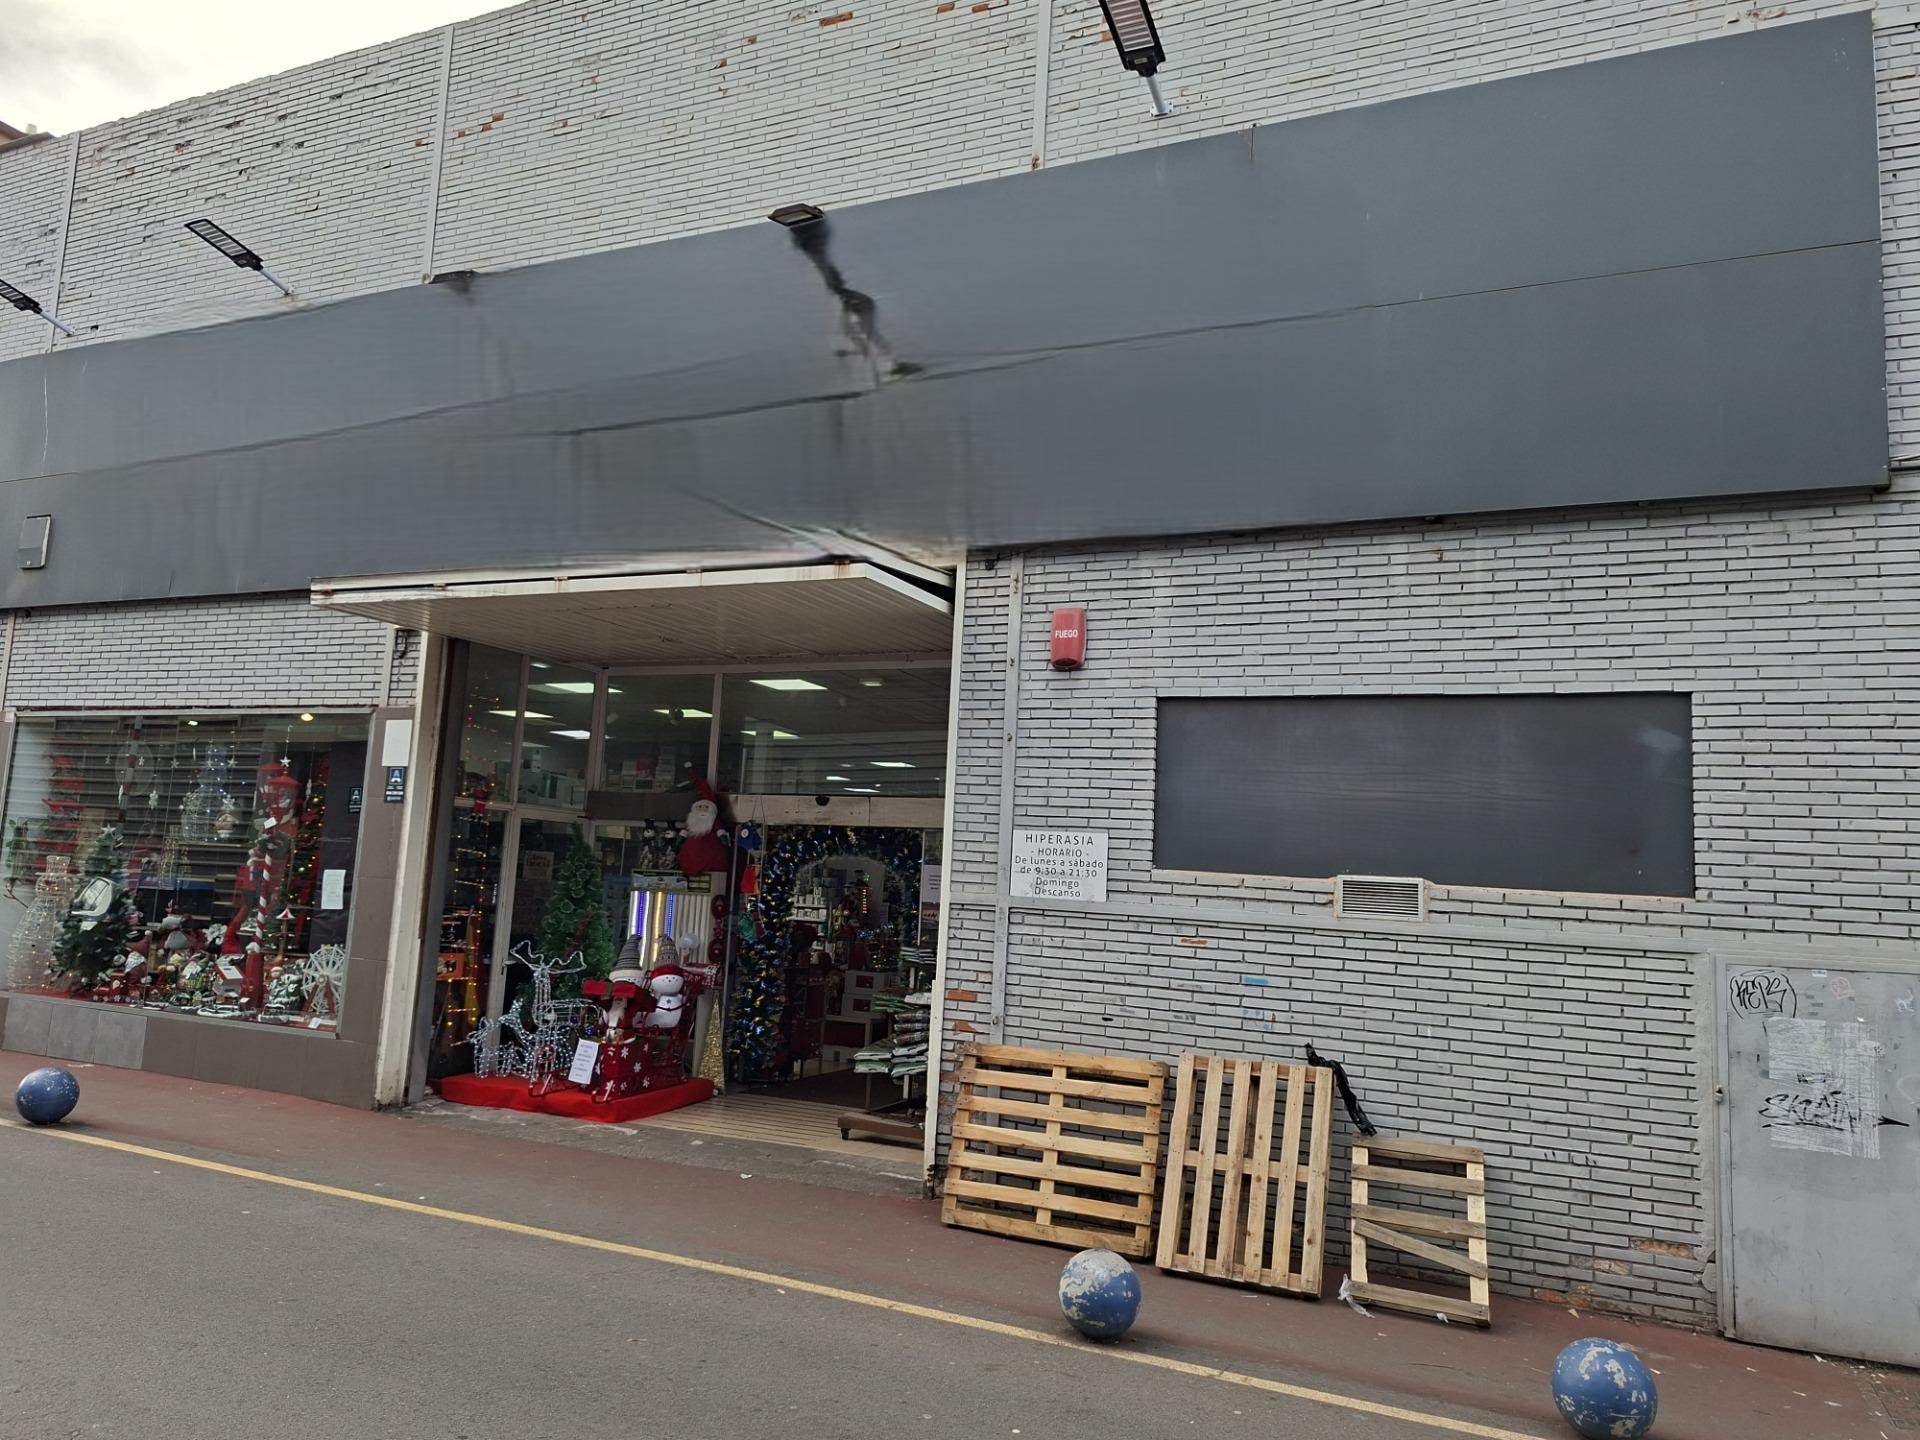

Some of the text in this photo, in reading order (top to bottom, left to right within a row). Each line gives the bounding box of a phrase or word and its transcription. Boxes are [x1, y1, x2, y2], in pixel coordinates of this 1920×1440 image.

[1055, 629, 1079, 638] FUEGO
[1025, 834, 1094, 846] HIPERASIA
[1038, 848, 1082, 857] HORARIO
[1015, 856, 1027, 864] De
[1031, 857, 1056, 866] lunes
[1069, 859, 1103, 868] sábado
[1035, 867, 1056, 875] 9:30
[1069, 869, 1097, 877] 21:30
[1036, 877, 1079, 889] Domingo
[1034, 887, 1080, 897] Descanso
